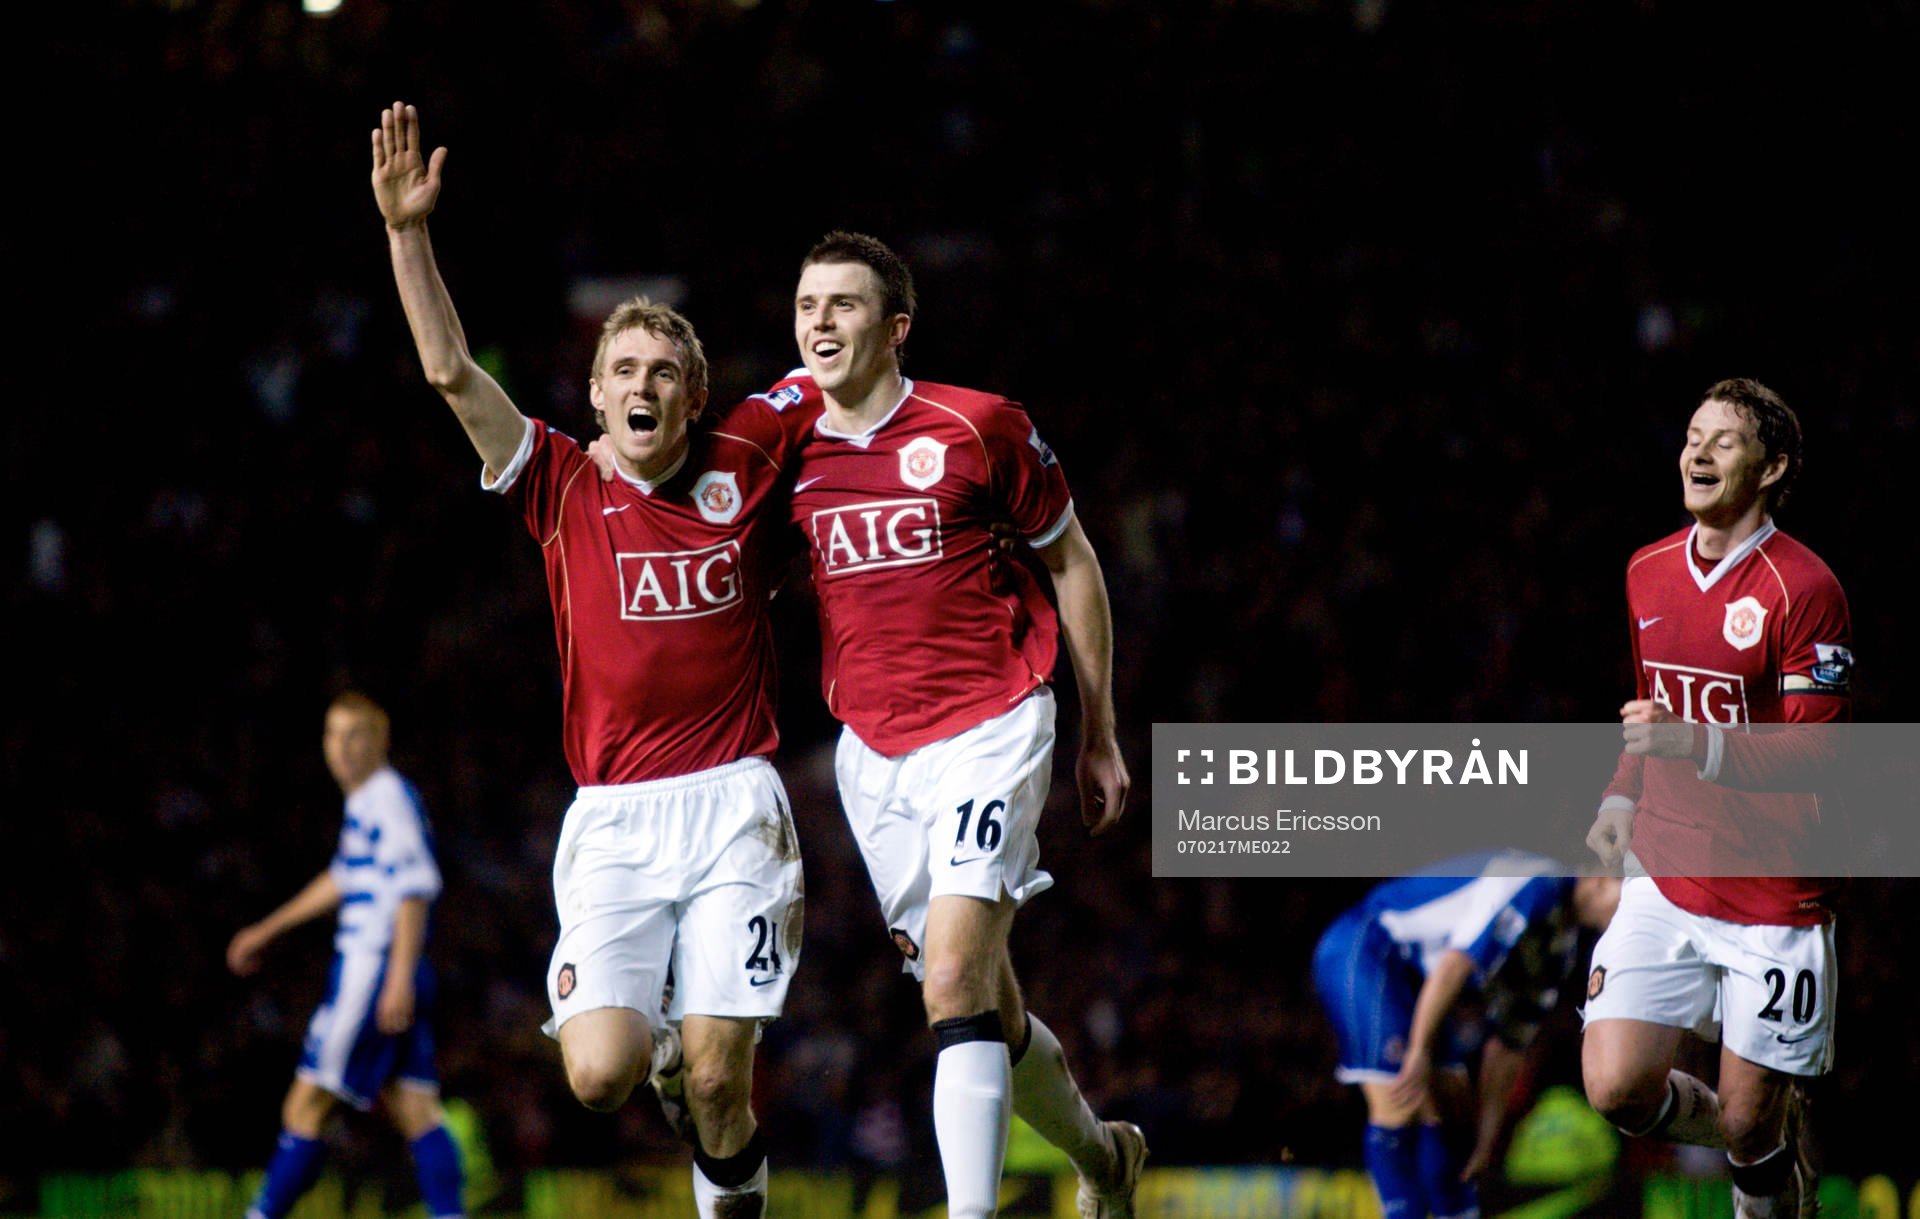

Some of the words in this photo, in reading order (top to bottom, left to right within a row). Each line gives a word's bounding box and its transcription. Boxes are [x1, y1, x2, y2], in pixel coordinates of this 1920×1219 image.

[828, 506, 933, 566] AIG
[628, 550, 737, 612] AIG
[1654, 669, 1740, 729] AIG
[954, 798, 1006, 852] 16
[1758, 968, 1817, 1025] 20
